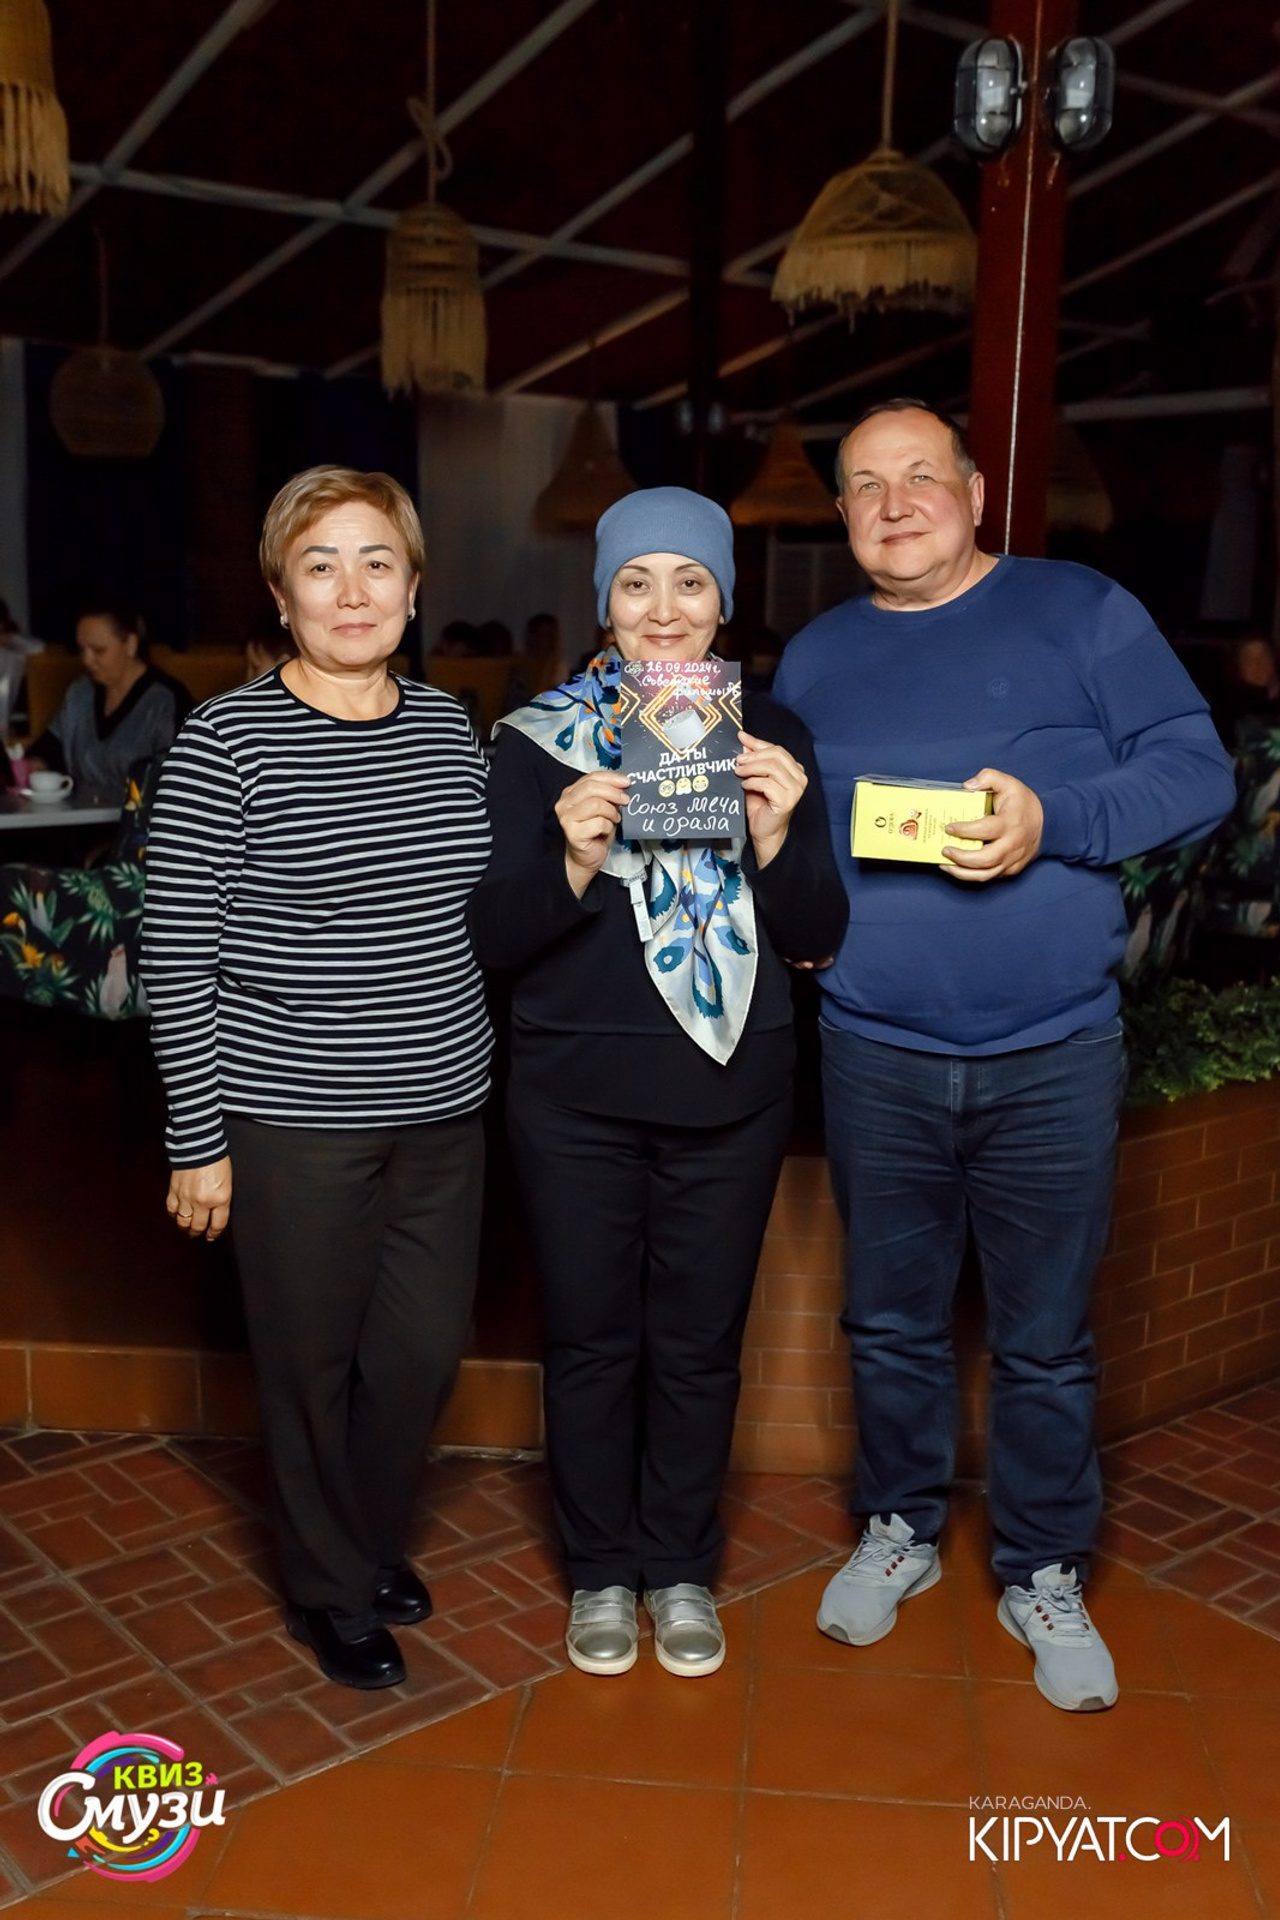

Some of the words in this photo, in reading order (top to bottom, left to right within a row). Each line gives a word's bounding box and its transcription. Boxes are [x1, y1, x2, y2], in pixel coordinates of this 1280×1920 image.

[659, 752, 681, 767] ДА
[685, 747, 707, 761] ТЫ
[627, 758, 736, 785] СЧАСТЛИВЧИК
[627, 793, 678, 816] Союз
[642, 818, 655, 832] и
[663, 815, 730, 837] орала
